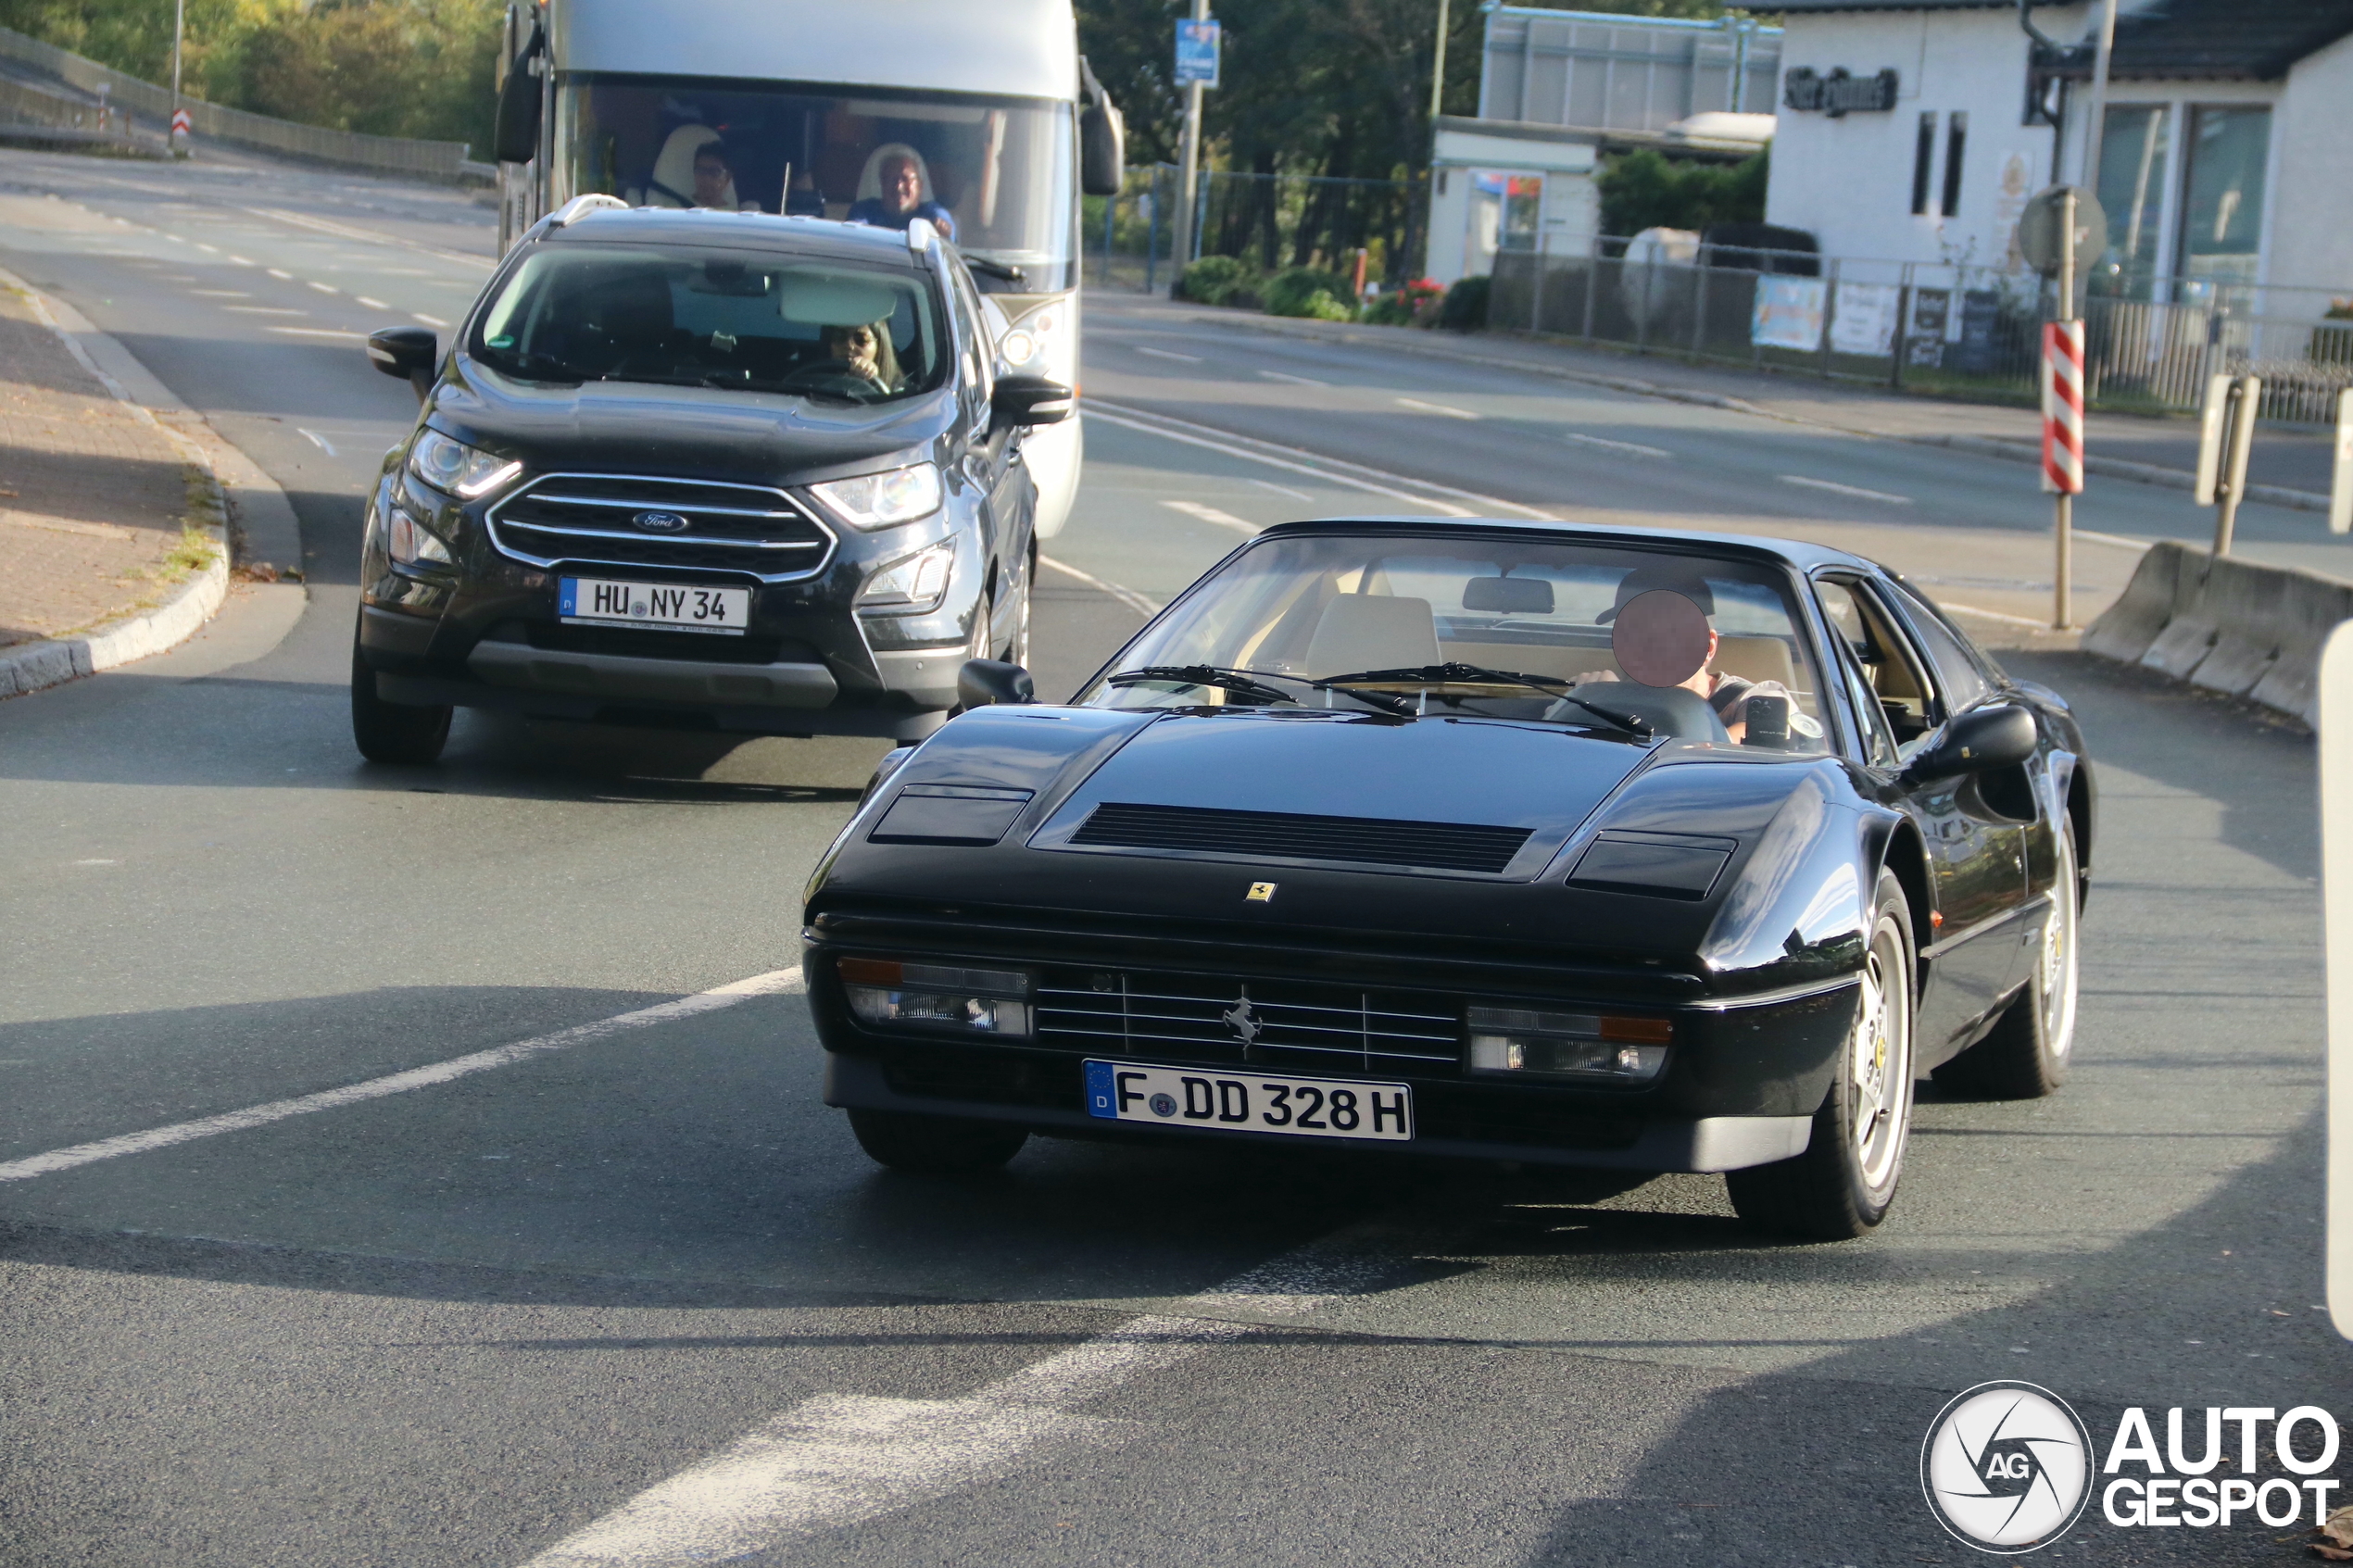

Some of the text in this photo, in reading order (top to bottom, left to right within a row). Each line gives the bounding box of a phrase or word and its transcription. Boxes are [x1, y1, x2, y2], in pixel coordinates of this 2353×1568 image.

[644, 513, 673, 527] Ford
[563, 599, 572, 609] D
[594, 583, 725, 621] HU NY 34
[1096, 1095, 1108, 1109] D
[1116, 1071, 1148, 1113] F
[1180, 1076, 1250, 1123] DD
